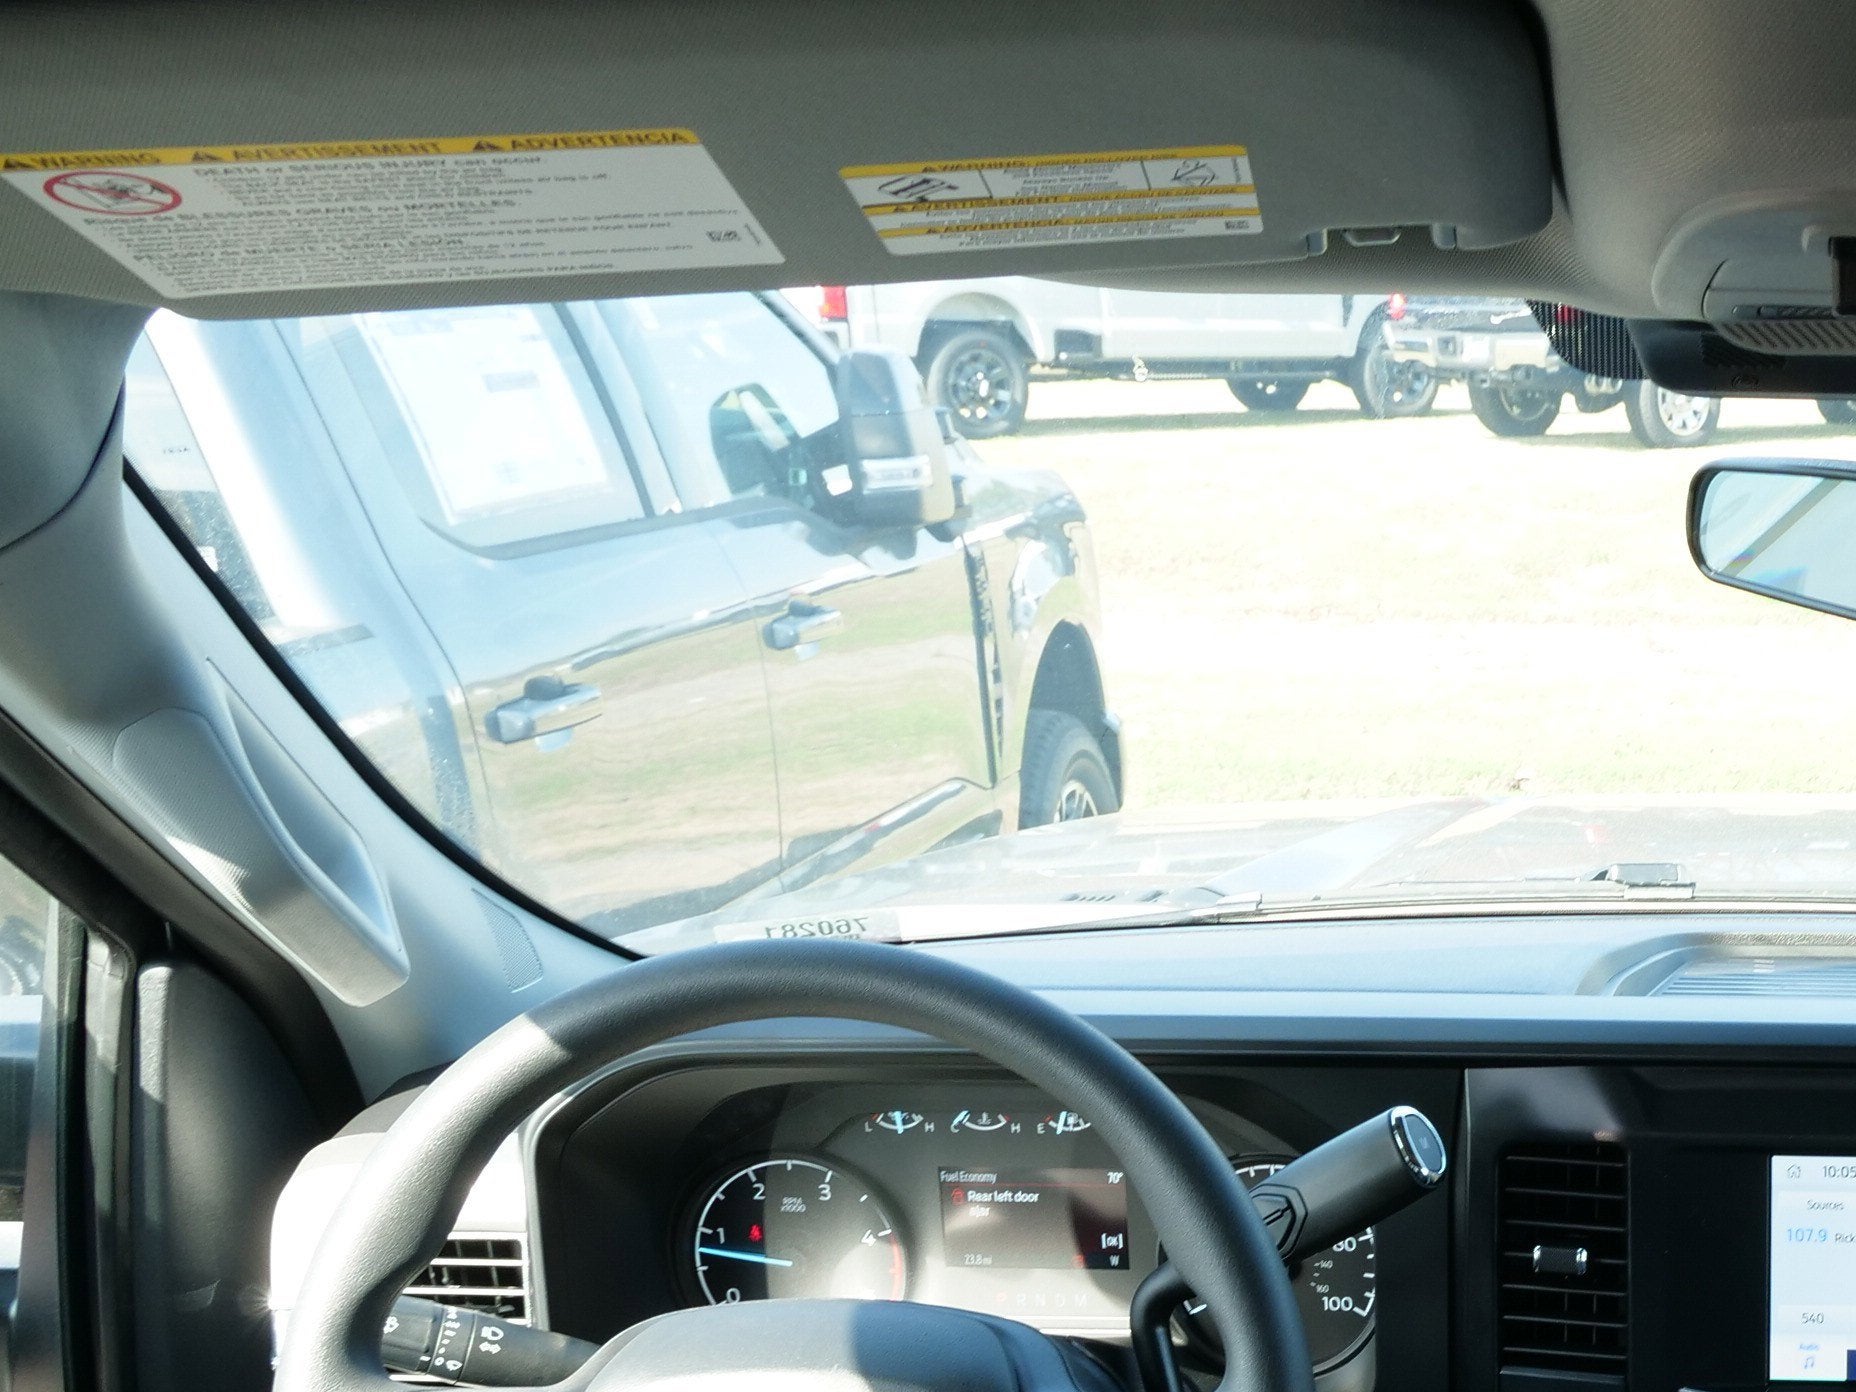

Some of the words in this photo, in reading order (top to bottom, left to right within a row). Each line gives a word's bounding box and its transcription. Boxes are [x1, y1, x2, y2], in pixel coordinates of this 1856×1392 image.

[511, 131, 688, 150] ADVERTENCIA
[752, 1183, 766, 1200] 2
[818, 1183, 832, 1201] 3
[967, 1190, 993, 1203] Rear
[994, 1190, 1013, 1203] left
[1014, 1191, 1040, 1203] door
[716, 1226, 726, 1244] 1
[860, 1229, 877, 1247] 4
[1786, 1228, 1829, 1244] 107.9
[1322, 1296, 1354, 1312] 100
[1801, 1312, 1825, 1325] 540
